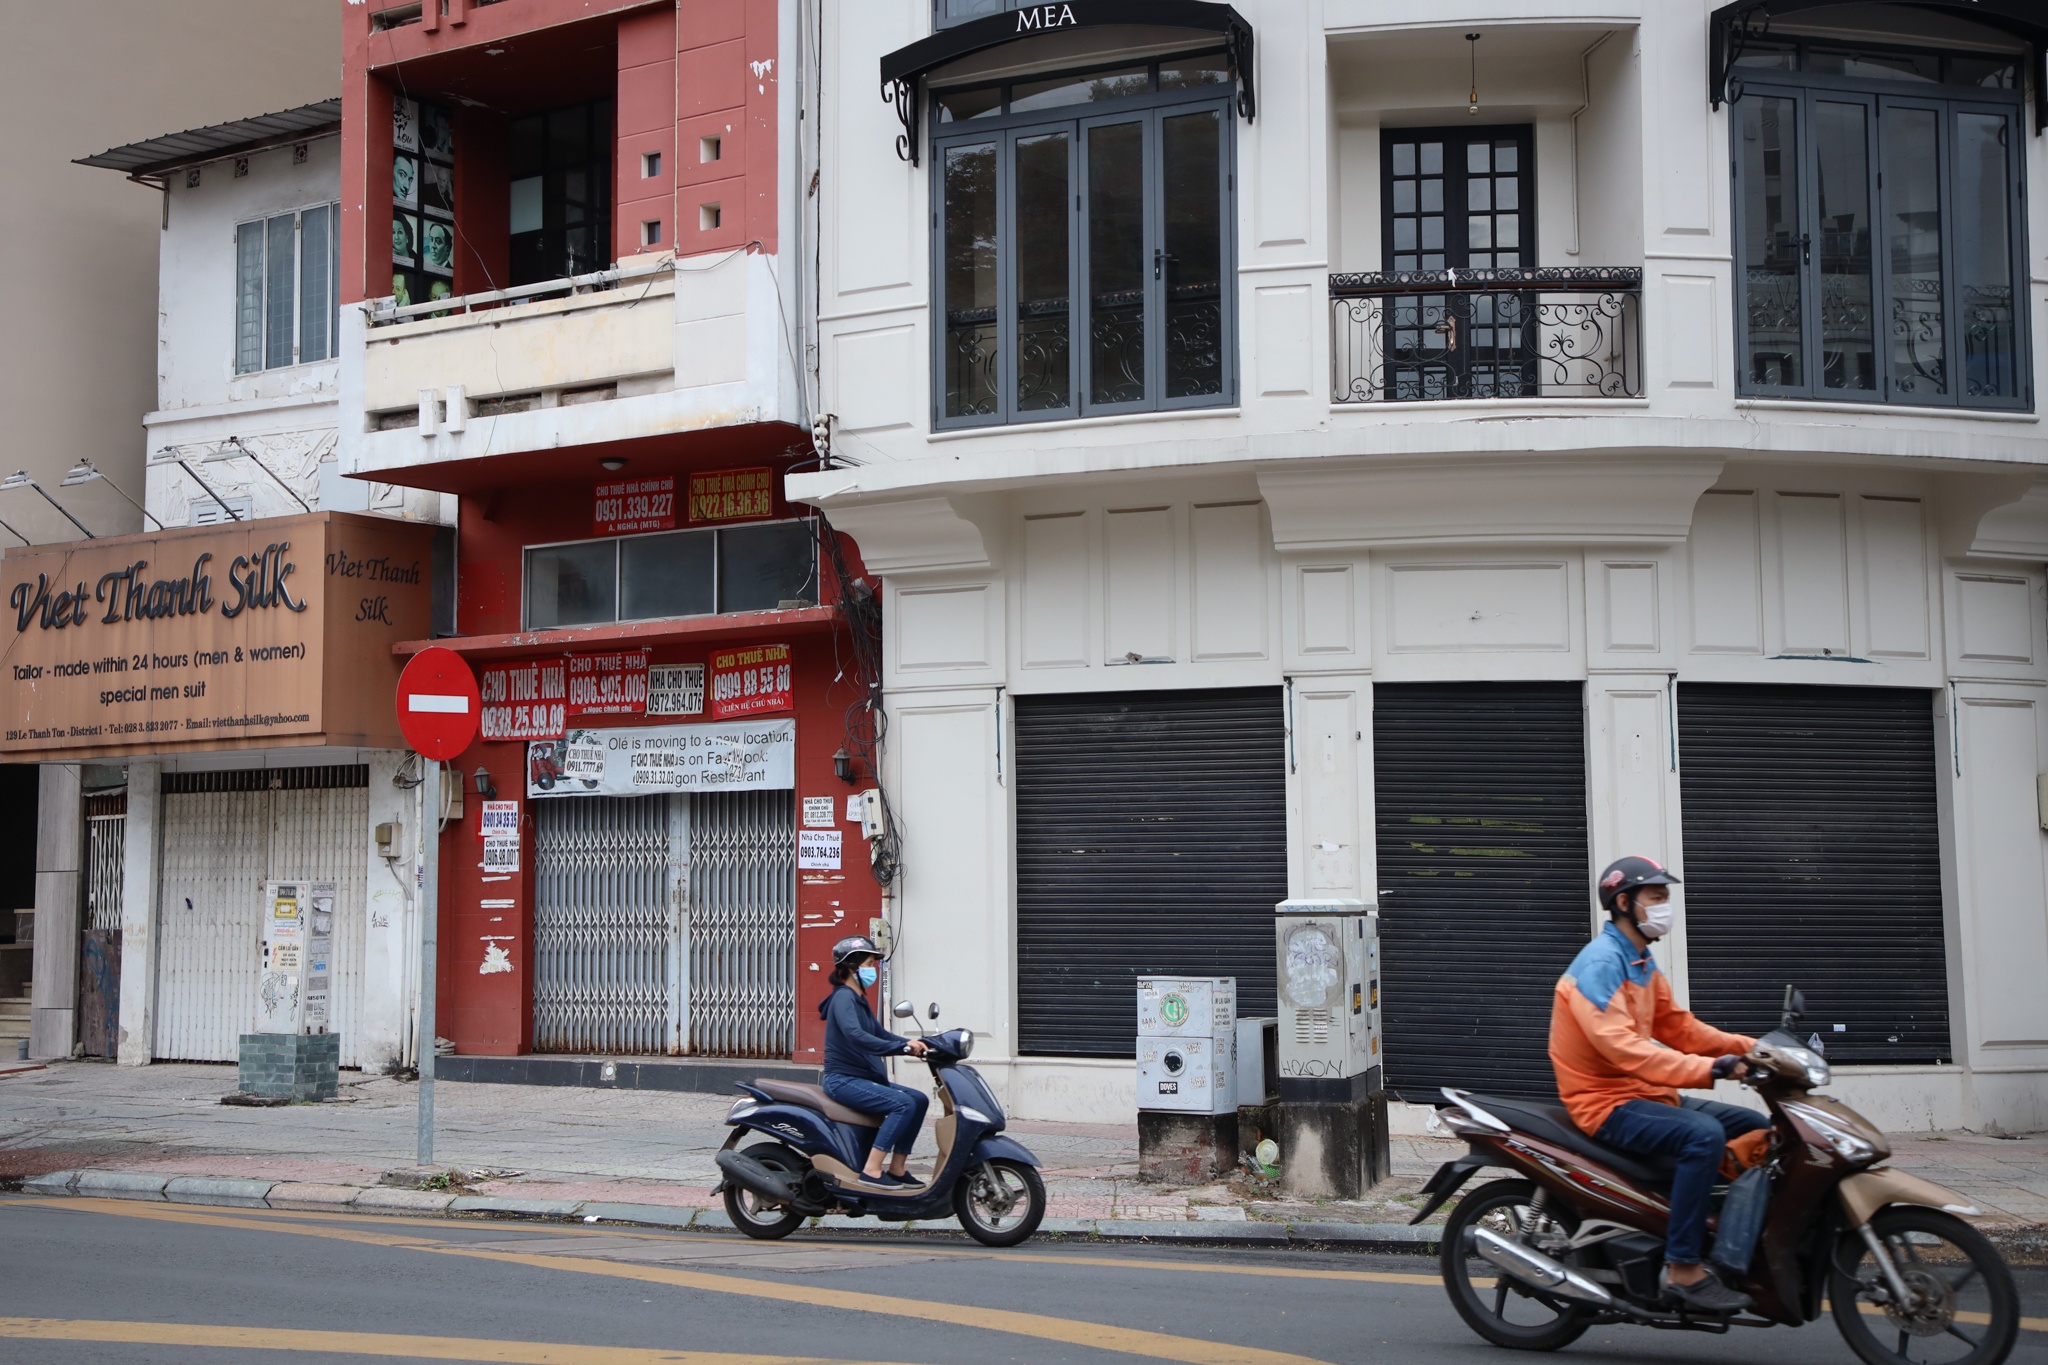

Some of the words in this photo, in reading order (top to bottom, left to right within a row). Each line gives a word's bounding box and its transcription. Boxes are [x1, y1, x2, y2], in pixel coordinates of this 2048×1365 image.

[1016, 4, 1077, 32] MEA
[596, 486, 609, 497] CHO
[610, 482, 625, 495] THUÊ
[627, 480, 639, 493] NHÀ
[693, 478, 705, 493] CHO
[596, 493, 673, 522] 0931.339.227
[691, 490, 768, 519] 0922.16.36.36
[640, 520, 660, 530] (MTG)
[326, 550, 364, 578] Viet
[366, 557, 421, 586] Thanh
[11, 572, 89, 632] Viet
[96, 552, 214, 624] Thanh
[222, 541, 306, 618] Silk
[356, 598, 392, 626] Silk
[13, 664, 43, 681] Tailor
[53, 660, 90, 678] made
[93, 654, 128, 675] within
[132, 654, 149, 671] 24
[152, 652, 188, 670] hours
[193, 647, 229, 668] (men
[234, 647, 244, 662] &
[249, 642, 306, 662] women)
[570, 657, 591, 672] CHO
[595, 653, 622, 670] THUÊ
[625, 651, 647, 669] NHÀ
[716, 654, 735, 668] CHO
[737, 647, 763, 665] THUÊ
[482, 670, 506, 702] CHO
[510, 661, 538, 700] THUÊ
[541, 660, 565, 699] NHÀ
[650, 667, 665, 689] NHÀ
[668, 671, 682, 689] CHO
[714, 671, 741, 701] 0909
[744, 669, 757, 696] 88
[760, 666, 774, 694] 55
[777, 664, 790, 692] 60
[100, 686, 147, 706] special
[150, 686, 180, 701] men
[184, 681, 206, 699] suit
[570, 674, 646, 705] 0906.905.006
[648, 692, 702, 712] 0972.964.076
[6, 731, 17, 740] 129
[18, 730, 27, 740] Le
[29, 729, 51, 739] Thanh
[52, 728, 65, 738] Ton
[109, 724, 124, 735] Tel:
[124, 722, 137, 733] 028
[160, 720, 178, 731] 2077
[186, 718, 211, 729] Email:
[212, 713, 309, 728] vietthanhsilk@yahoo.com
[481, 704, 564, 737] 0938.25.99.09
[608, 737, 628, 751] Olé
[632, 737, 641, 749] is
[644, 734, 687, 751] moving
[690, 735, 701, 747] to
[704, 736, 711, 746] a
[716, 735, 740, 745] new
[743, 730, 793, 744] location.
[568, 749, 580, 759] CHO
[636, 752, 647, 767] CHO
[689, 755, 703, 765] on
[566, 760, 603, 773] 0911.7777.69
[483, 812, 496, 828] 0901
[503, 812, 510, 828] 35
[510, 812, 517, 828] 35
[486, 840, 496, 848] CHO
[497, 839, 508, 847] THUÊ
[802, 833, 813, 841] Nhà
[814, 833, 824, 841] Cho
[826, 833, 840, 841] Thuê
[800, 846, 840, 858] 0903.764.236
